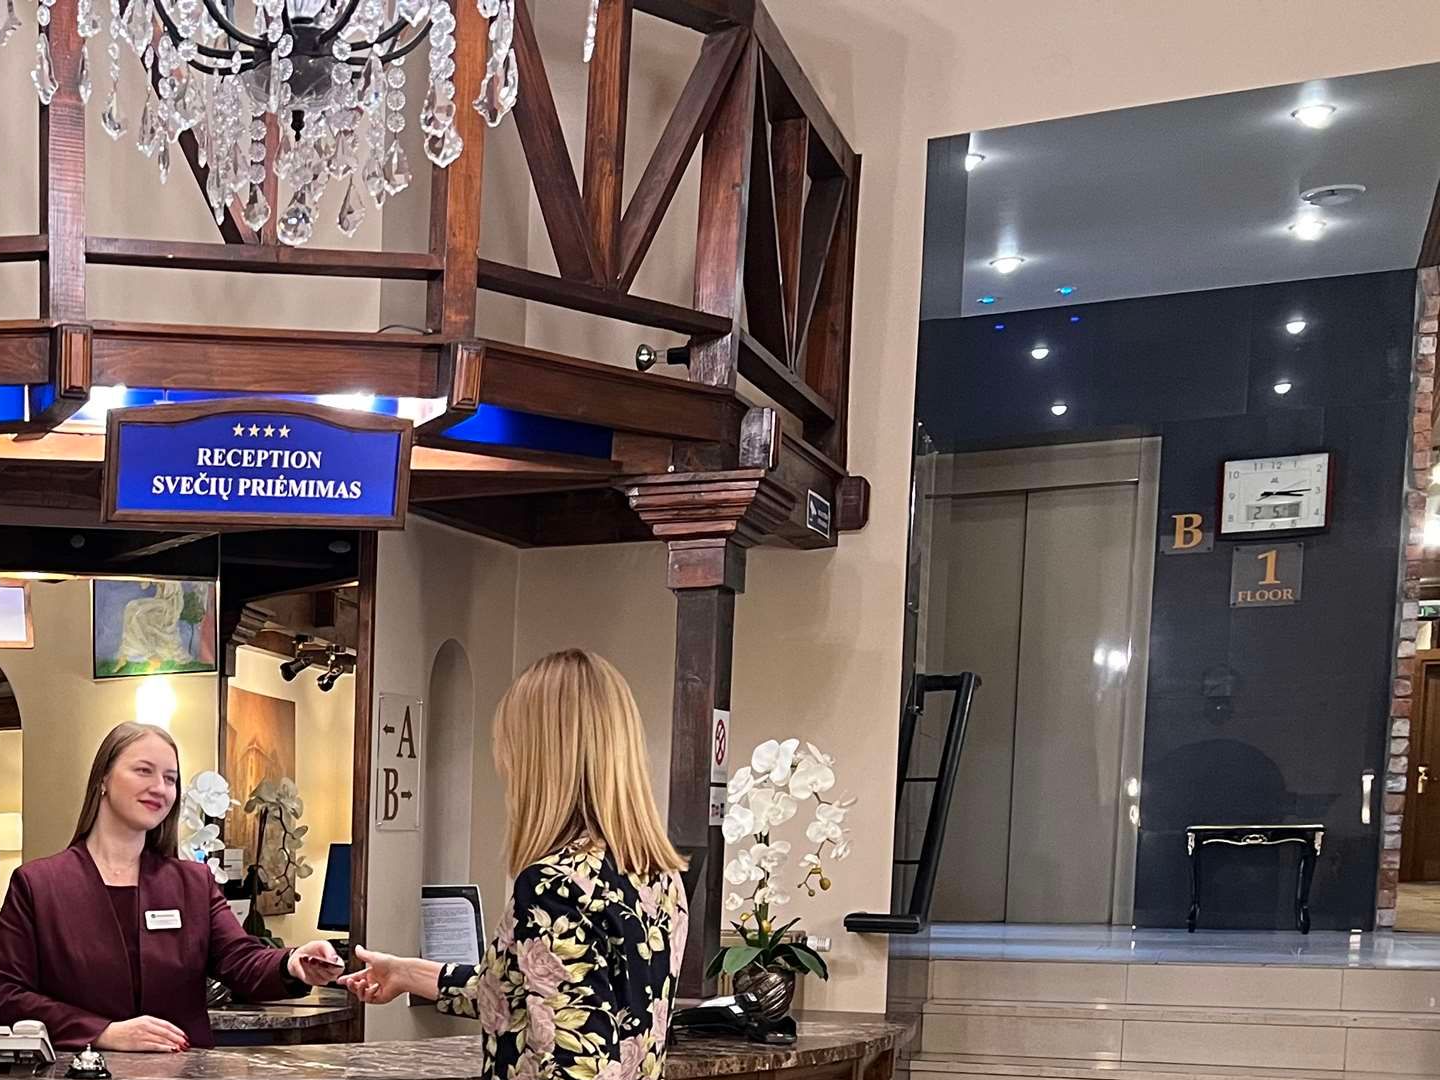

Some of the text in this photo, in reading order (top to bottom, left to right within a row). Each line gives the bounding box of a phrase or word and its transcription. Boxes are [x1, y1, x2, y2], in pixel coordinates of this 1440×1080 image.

[197, 448, 321, 469] RECEPTION
[1271, 461, 1282, 470] 12
[152, 473, 362, 500] SVEČIŲ PRIĖMIMAS
[1228, 470, 1240, 479] 10
[1171, 513, 1203, 550] B
[1257, 550, 1281, 585] 1
[1237, 588, 1293, 602] FLOOR
[396, 705, 416, 759] A
[383, 768, 399, 821] B
